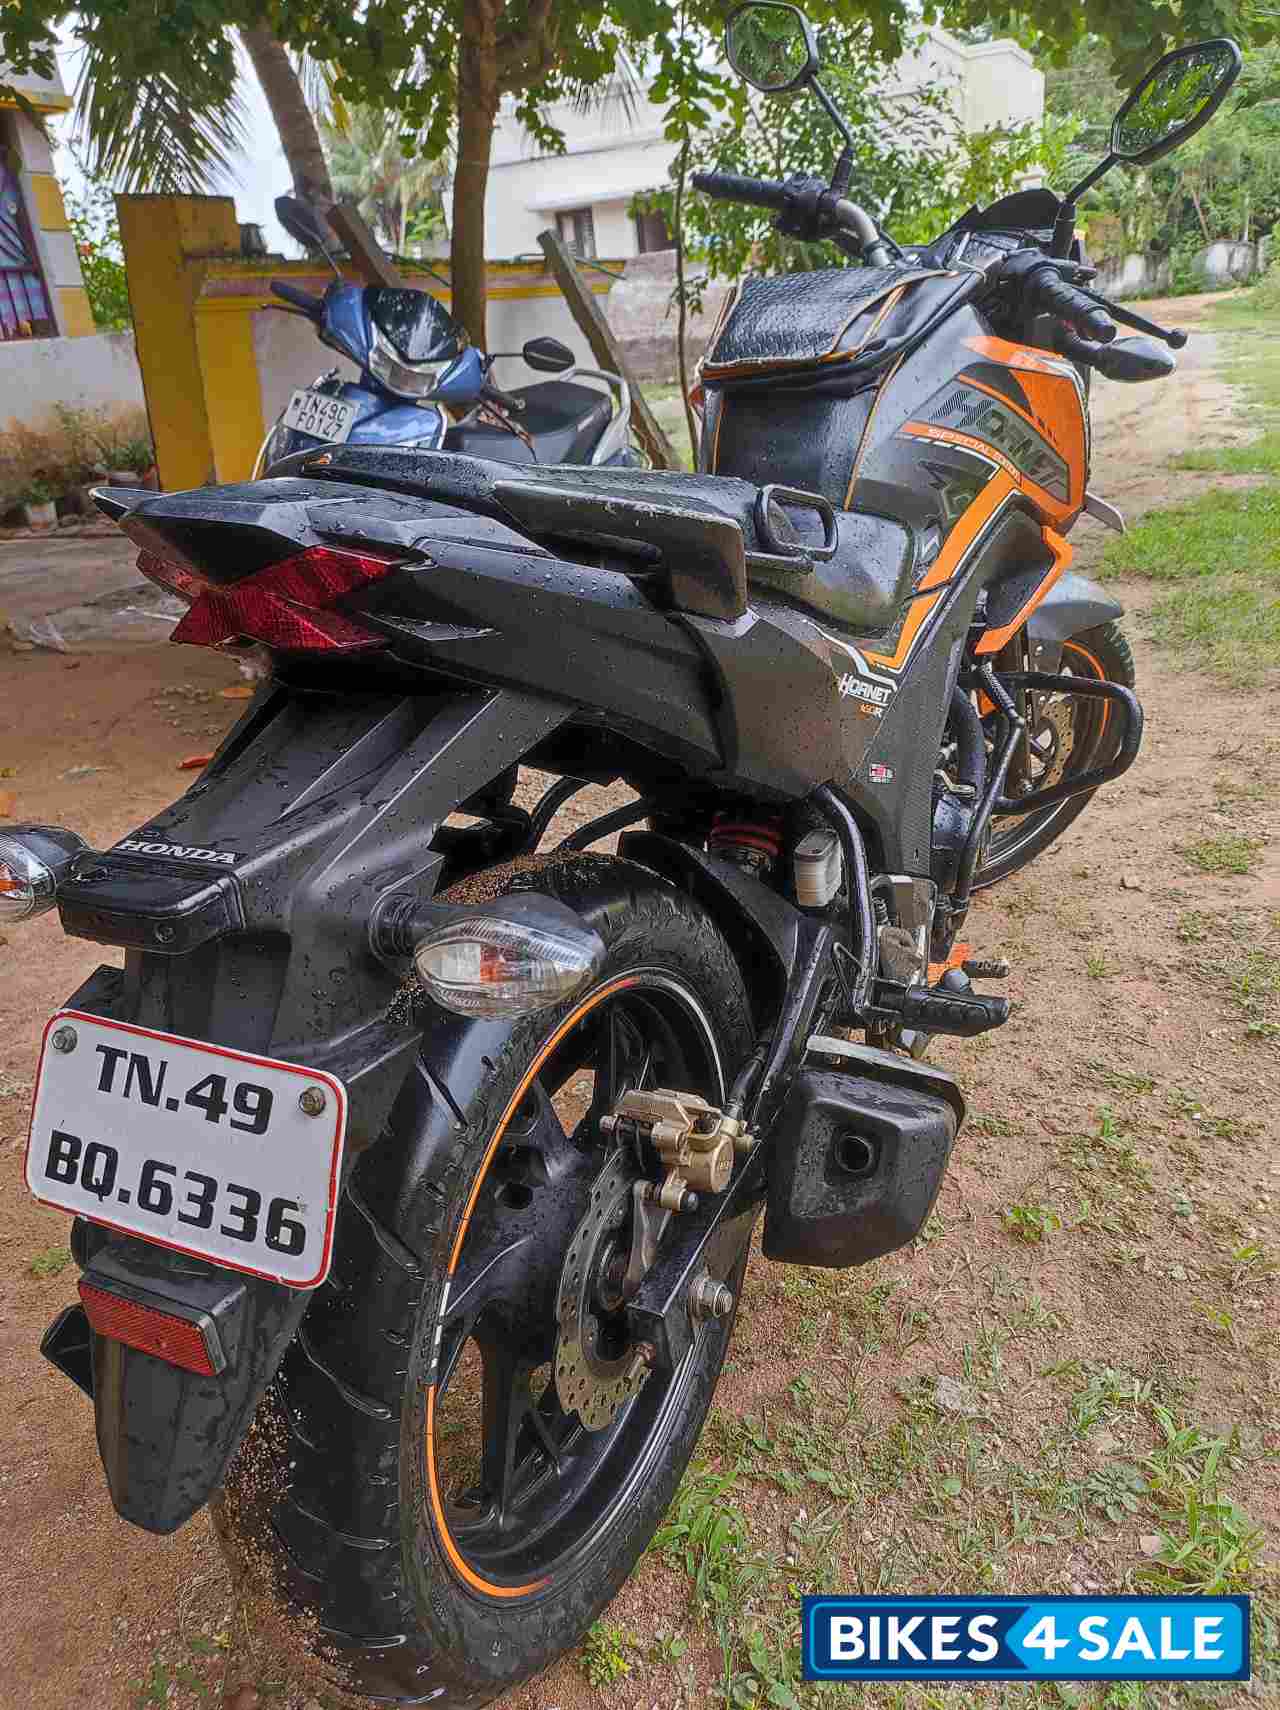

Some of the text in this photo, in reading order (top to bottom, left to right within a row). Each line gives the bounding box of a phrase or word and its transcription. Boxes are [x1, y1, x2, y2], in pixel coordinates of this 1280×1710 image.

[838, 673, 892, 703] HORNET
[117, 839, 237, 864] HONDA
[95, 1044, 274, 1136] TN.49
[44, 1129, 307, 1257] BQ.6336
